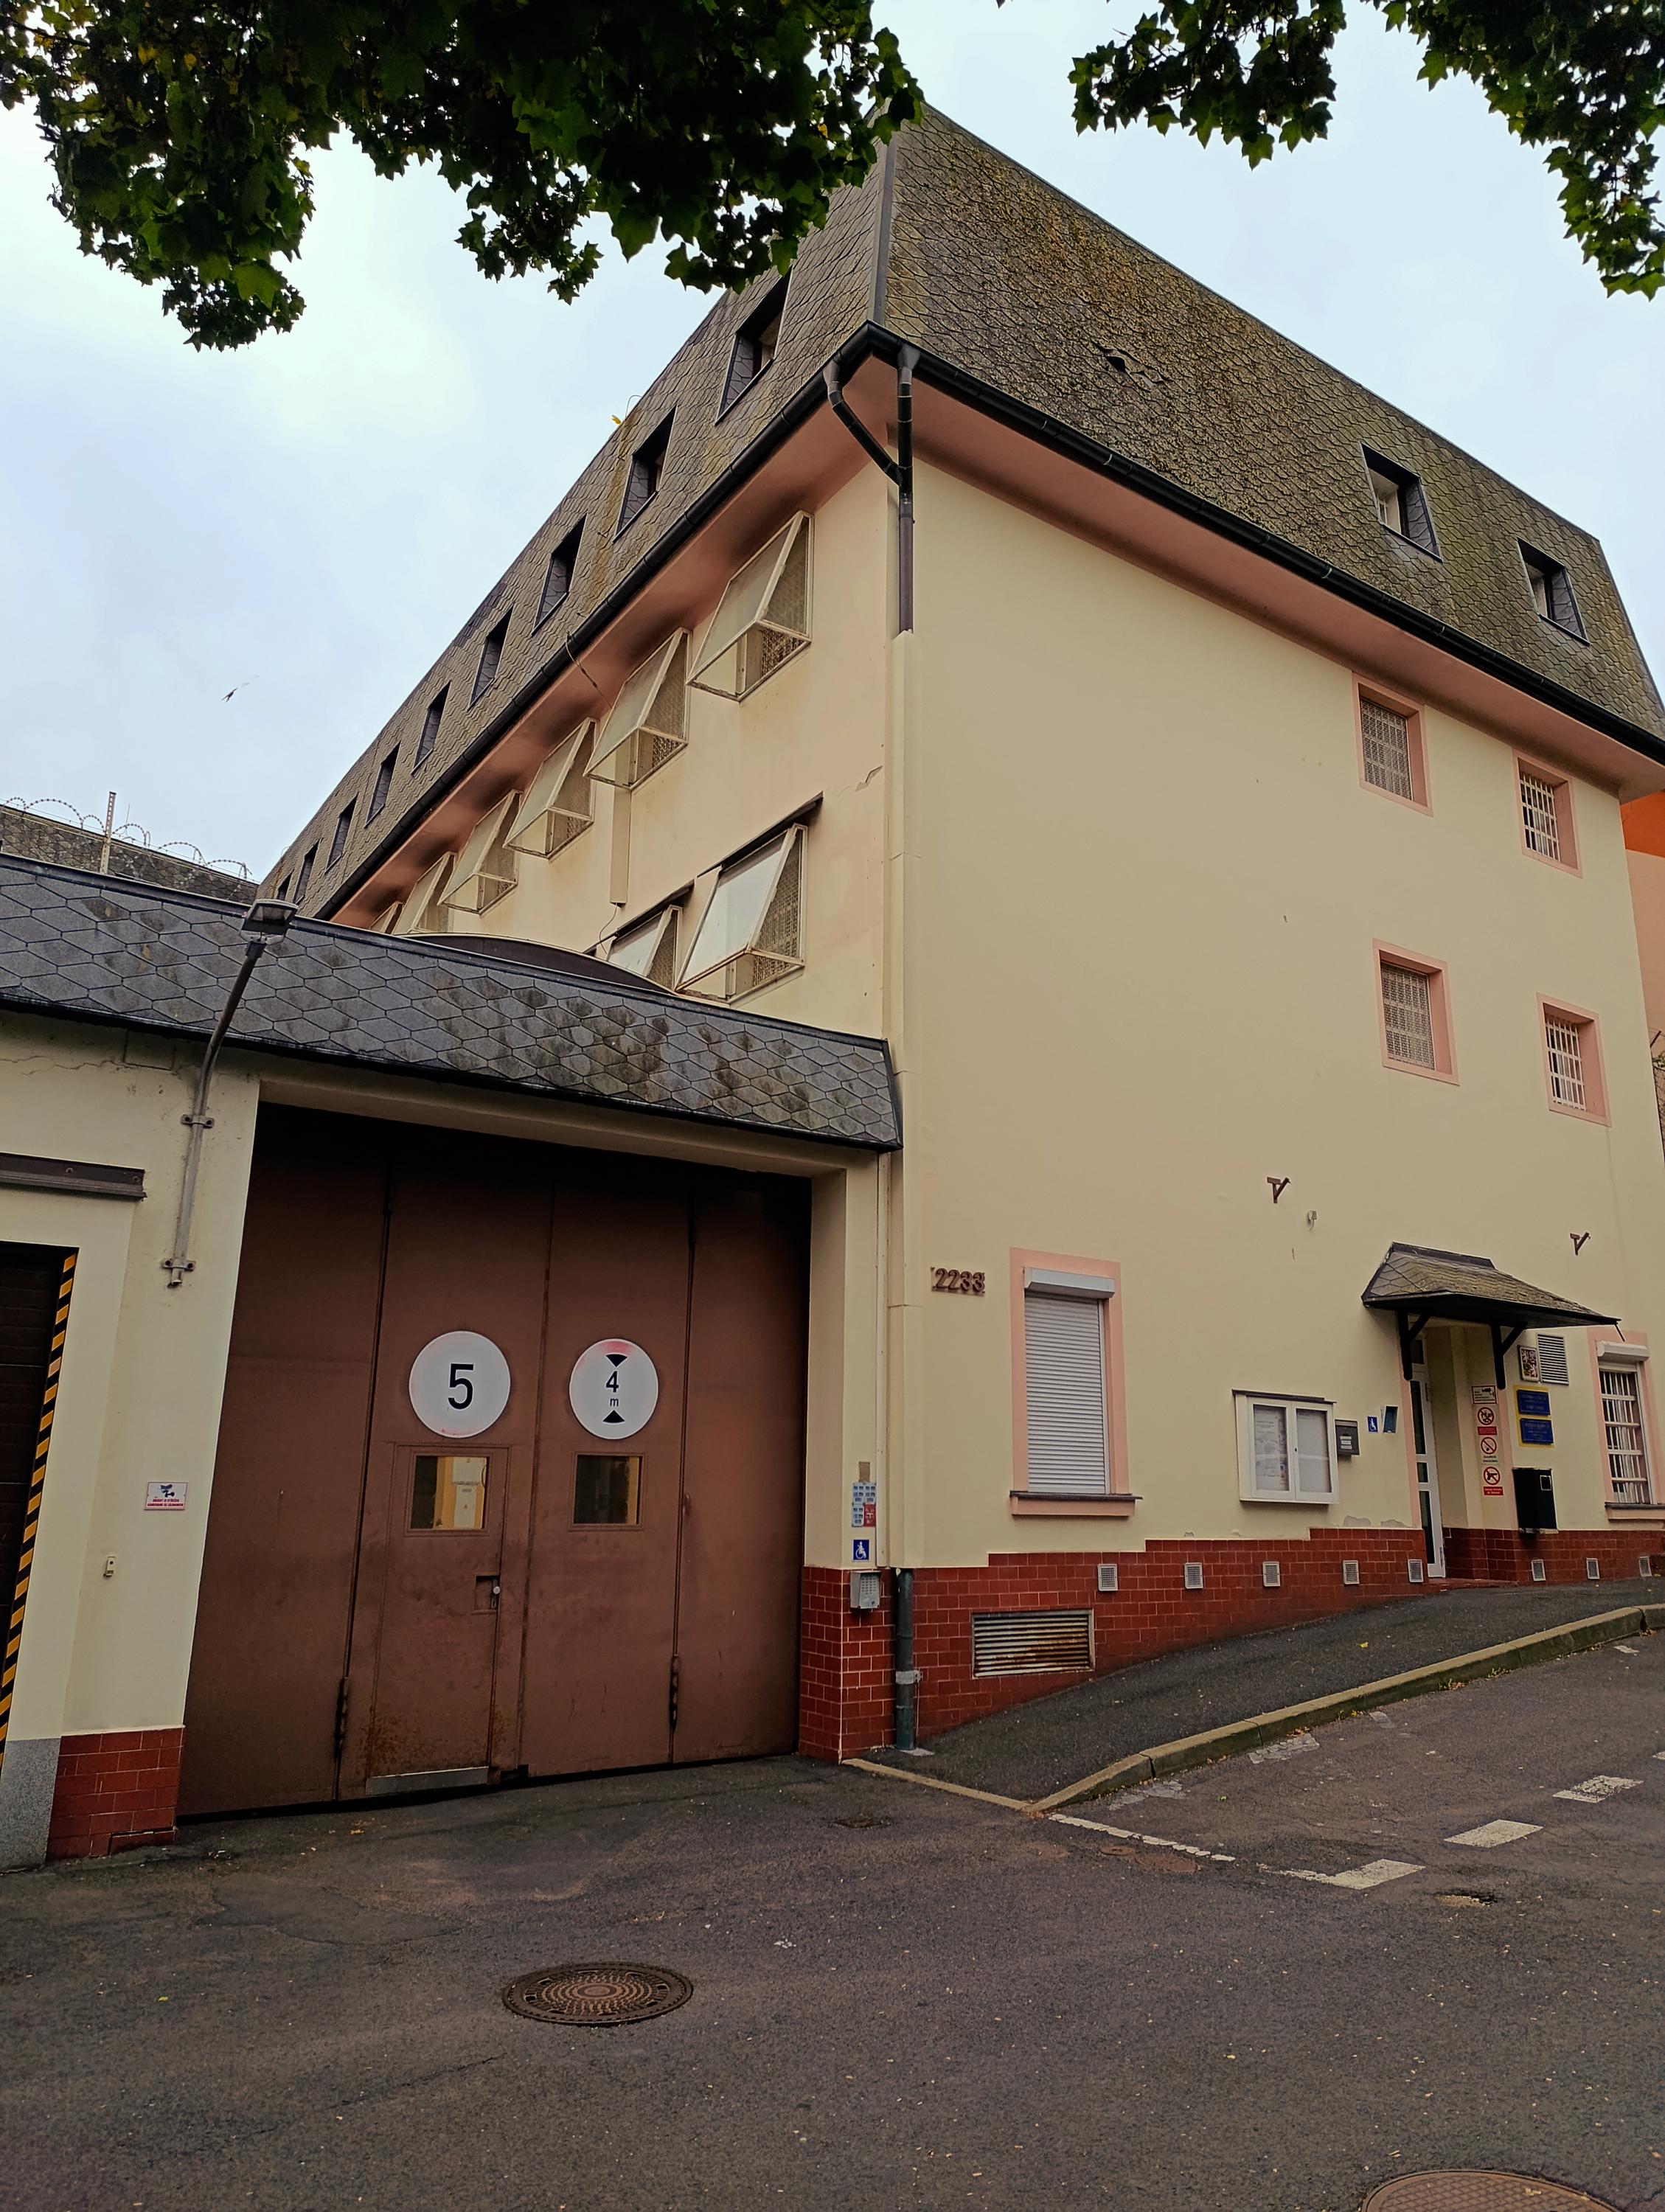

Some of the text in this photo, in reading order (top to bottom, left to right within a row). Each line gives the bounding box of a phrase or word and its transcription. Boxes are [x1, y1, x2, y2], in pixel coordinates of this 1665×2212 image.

[935, 1267, 986, 1293] 2233
[448, 1363, 474, 1410] 5
[605, 1370, 619, 1393] 4
[609, 1398, 619, 1407] m
